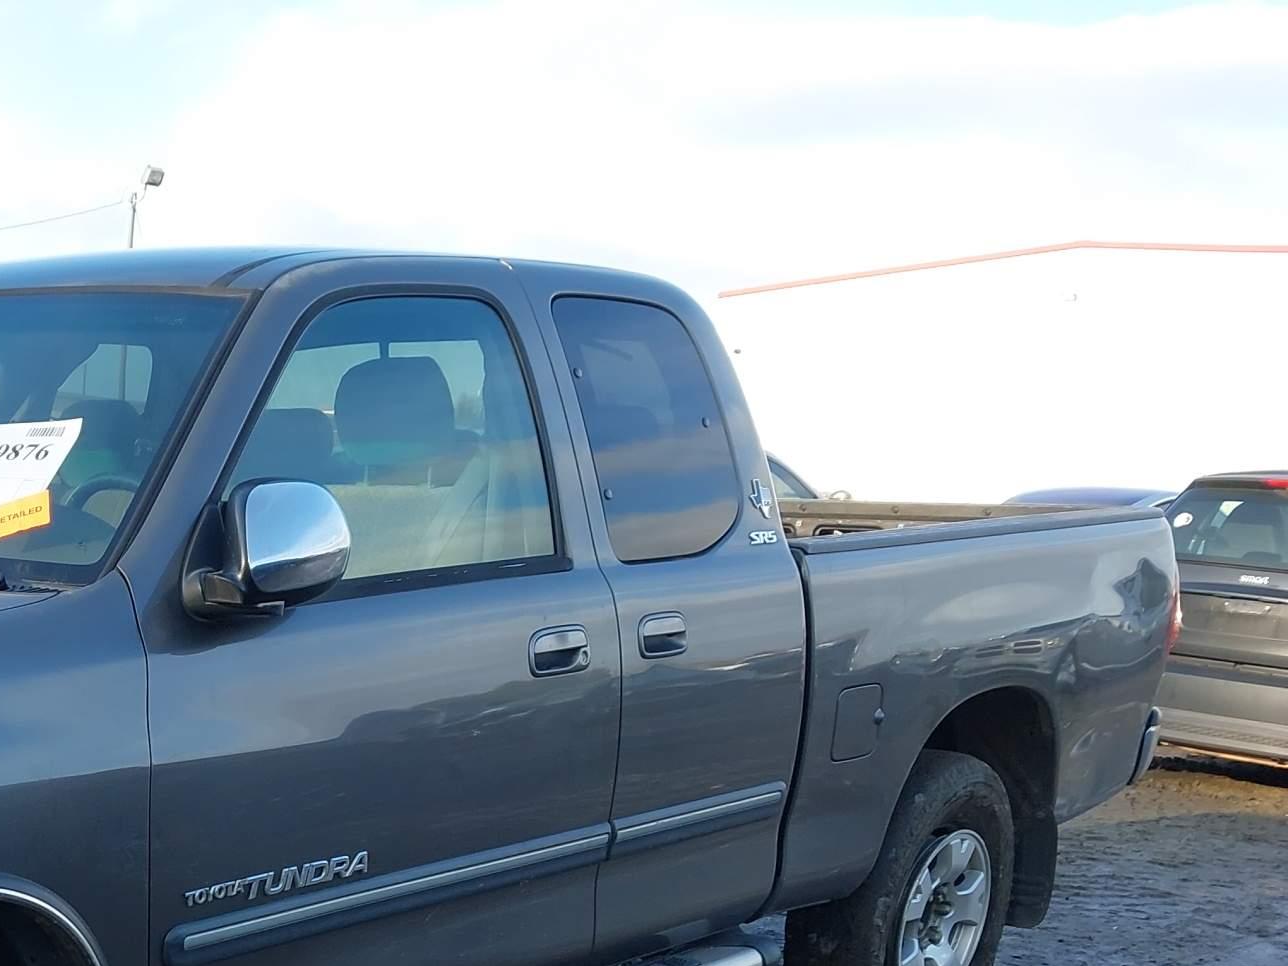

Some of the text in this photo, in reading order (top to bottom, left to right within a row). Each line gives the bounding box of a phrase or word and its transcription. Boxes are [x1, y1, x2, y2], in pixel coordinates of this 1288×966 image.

[748, 530, 777, 545] SR5
[184, 850, 369, 907] TOYOTA TUNDRA
